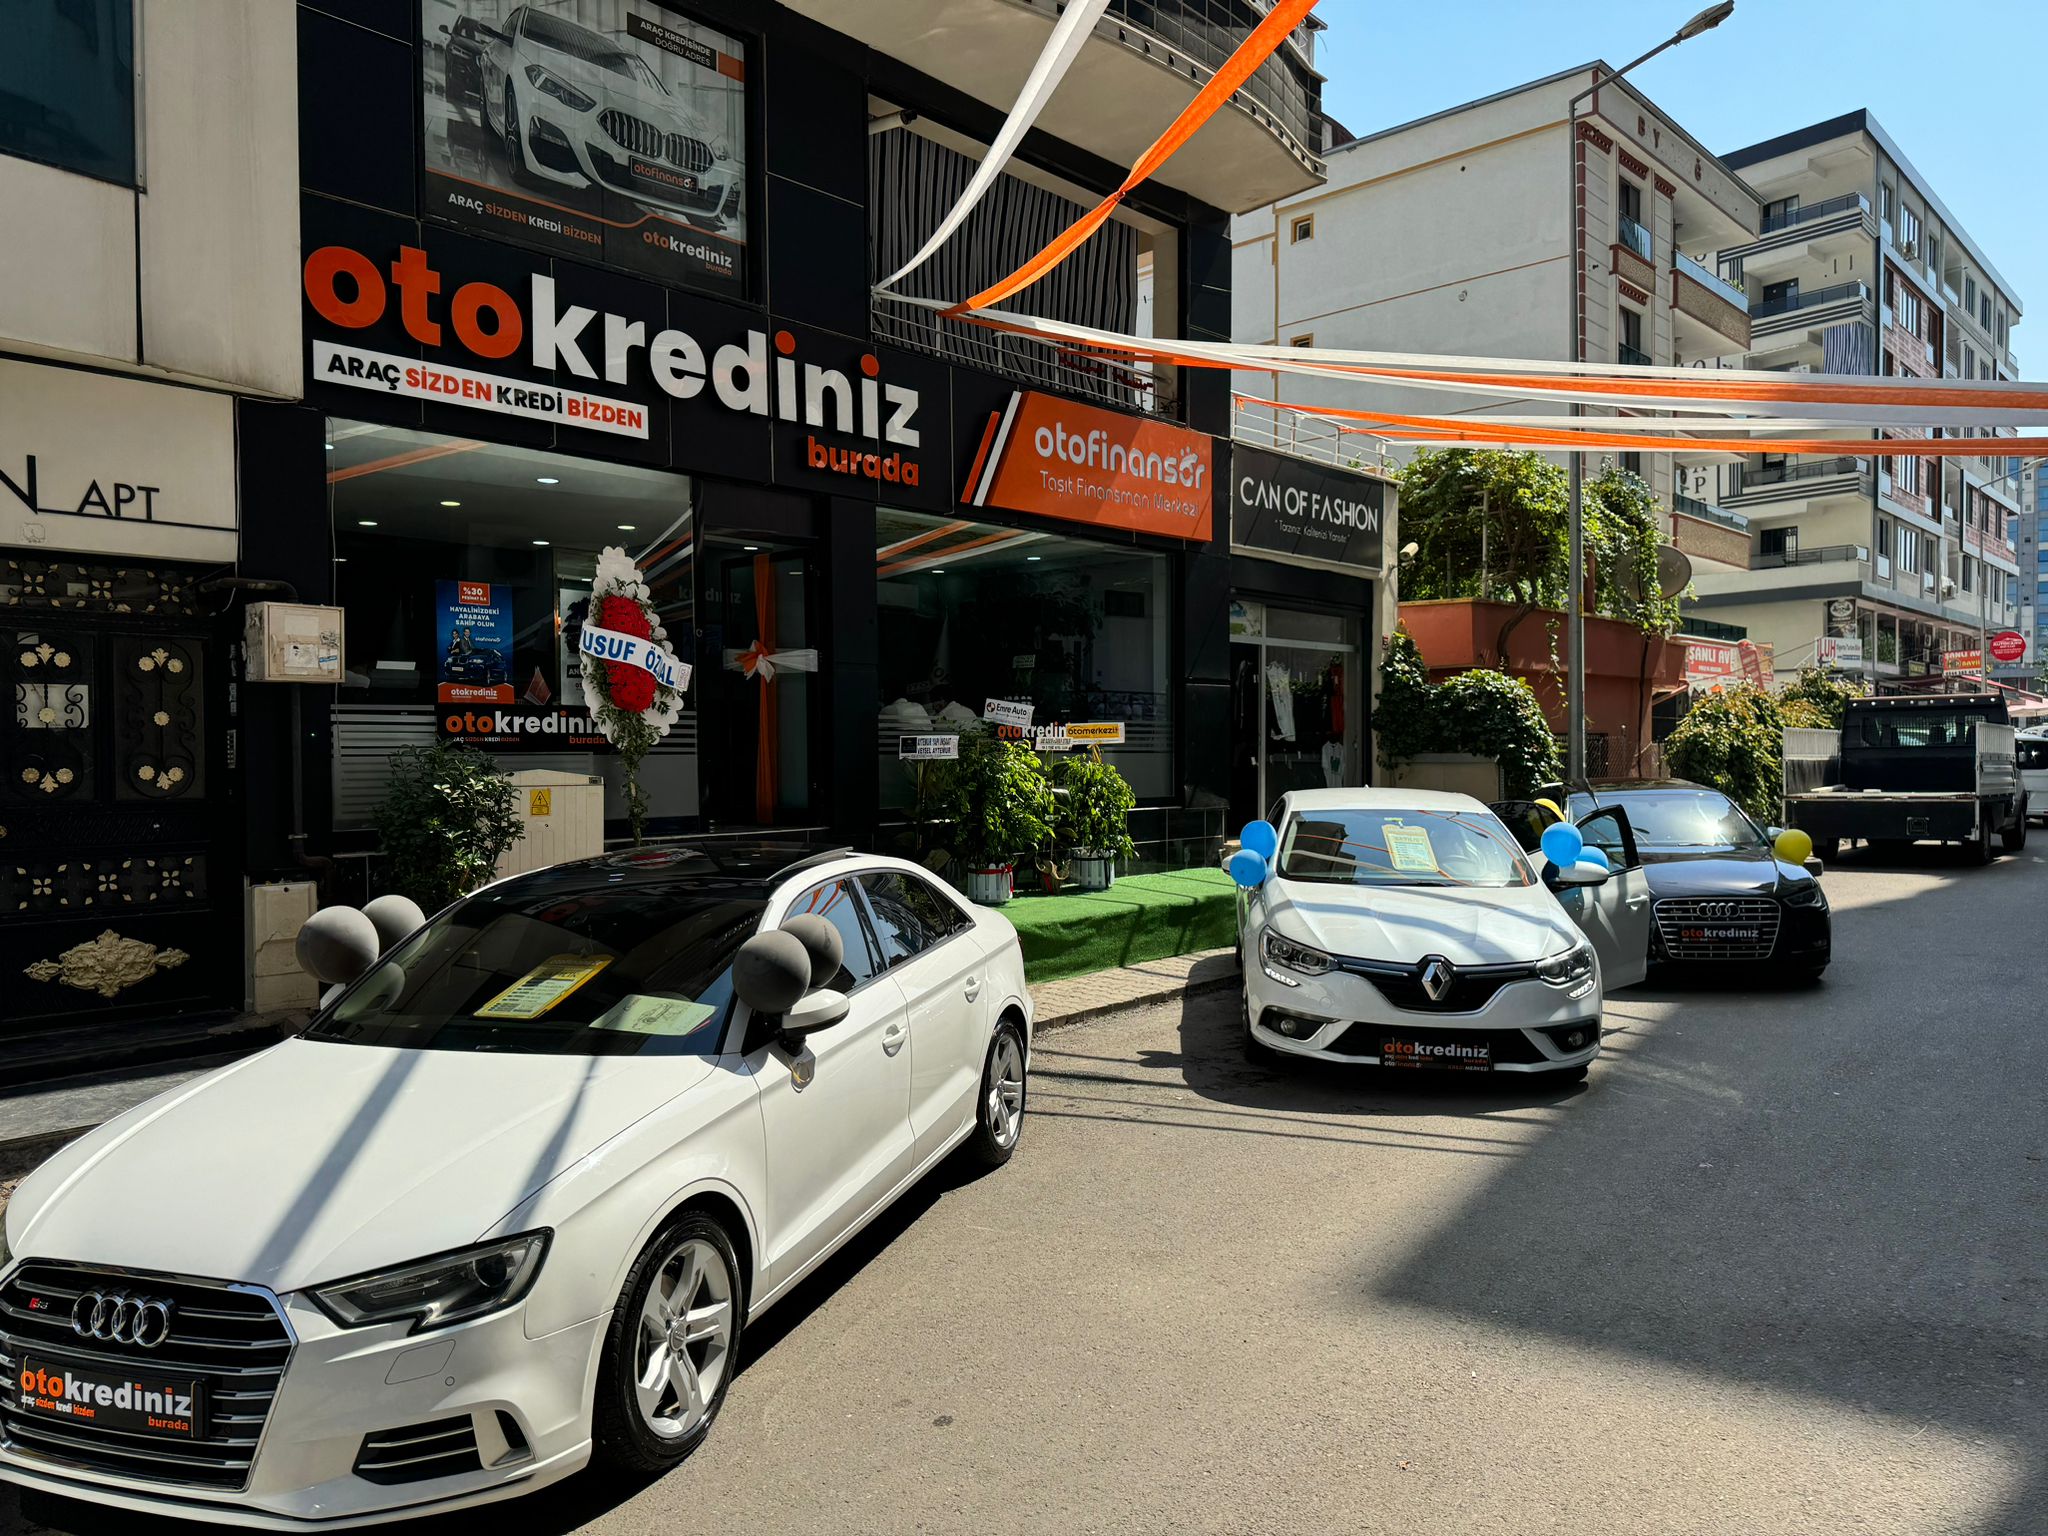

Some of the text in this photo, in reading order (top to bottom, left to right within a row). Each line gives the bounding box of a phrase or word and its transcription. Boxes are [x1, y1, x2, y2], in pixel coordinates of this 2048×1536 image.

[640, 21, 711, 56] ARAÇ KREDİSİNDE
[655, 37, 711, 66] DOĞRU ADRES
[448, 192, 602, 245] ARAÇ SİZDEN KREDİ BİZDEN
[643, 229, 732, 268] otokrediniz
[705, 262, 732, 276] burada
[304, 244, 920, 449] otokrediniz
[327, 353, 642, 429] ARAÇ SİZDEN KREDİ BİZDEN
[808, 436, 919, 486] burada
[77, 480, 160, 521] APT
[1040, 470, 1200, 517] Taşıt Finansman Merkezi
[1240, 476, 1378, 534] CAN OF FASHION
[463, 586, 482, 596] %30
[449, 606, 500, 615] HAYALİNİZDEKİ
[459, 613, 490, 621] ARABAYA
[477, 620, 495, 628] OLUN
[582, 629, 636, 660] USUF
[645, 646, 675, 686] ÖZAL
[1718, 650, 1730, 664] AV
[450, 687, 498, 697] otokrediniz
[996, 703, 1011, 713] Emre
[1012, 706, 1027, 716] Auto
[569, 735, 605, 744] burada
[1681, 928, 1760, 938] otokrediniz
[1383, 1041, 1489, 1057] otokrediniz
[20, 1367, 192, 1417] otokrediniz
[56, 1401, 72, 1413] kredi
[148, 1416, 189, 1431] burada
